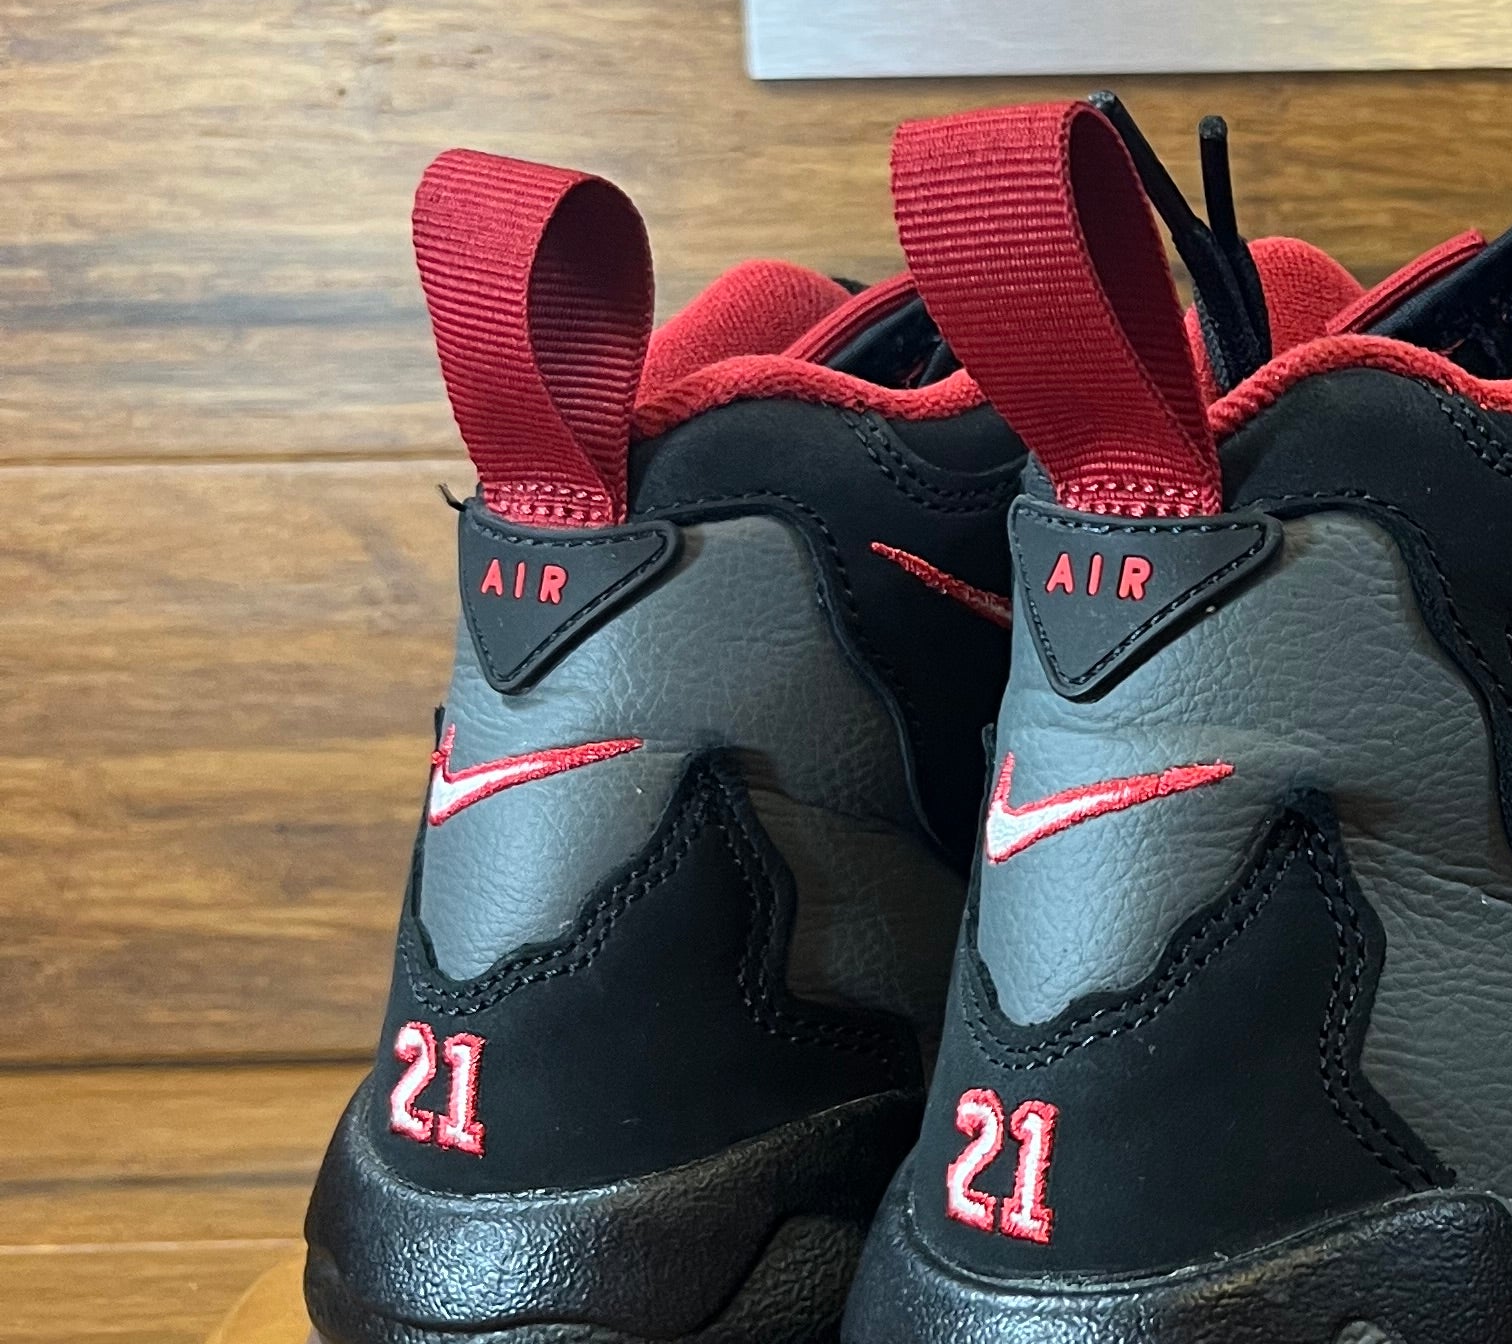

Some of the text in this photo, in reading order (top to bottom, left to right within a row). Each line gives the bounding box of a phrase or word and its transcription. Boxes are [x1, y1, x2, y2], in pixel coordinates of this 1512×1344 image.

[480, 557, 568, 606] AIR
[1045, 552, 1153, 602] AIR
[387, 1020, 488, 1158] 21
[944, 1086, 1060, 1246] 21
